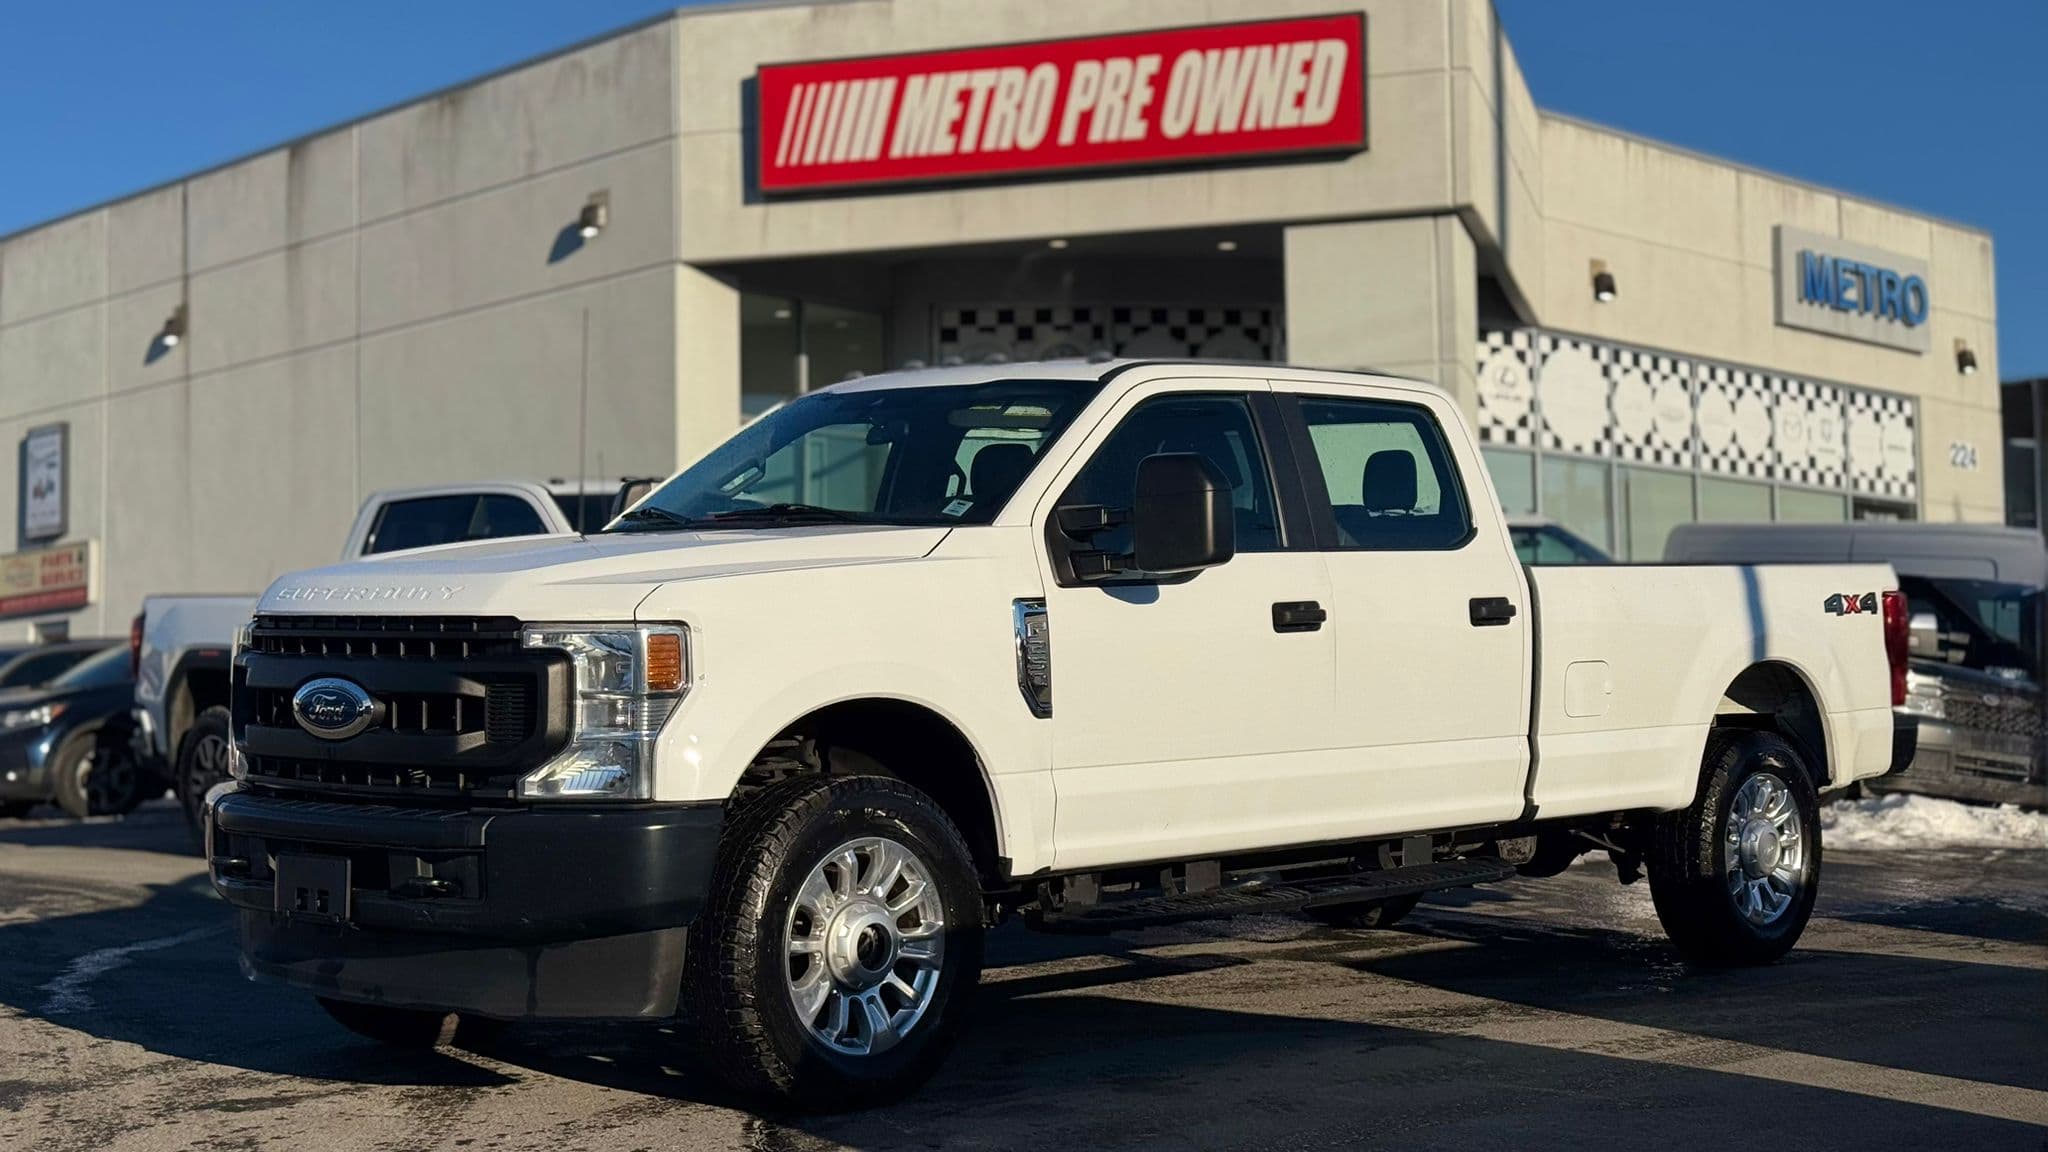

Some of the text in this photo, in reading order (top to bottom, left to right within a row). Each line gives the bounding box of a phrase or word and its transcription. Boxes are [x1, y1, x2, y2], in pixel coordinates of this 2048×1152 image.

[887, 38, 1349, 160] METRO PRE OWNED
[1798, 249, 1929, 328] METRO
[1950, 442, 1978, 469] 224
[308, 693, 347, 721] Ford
